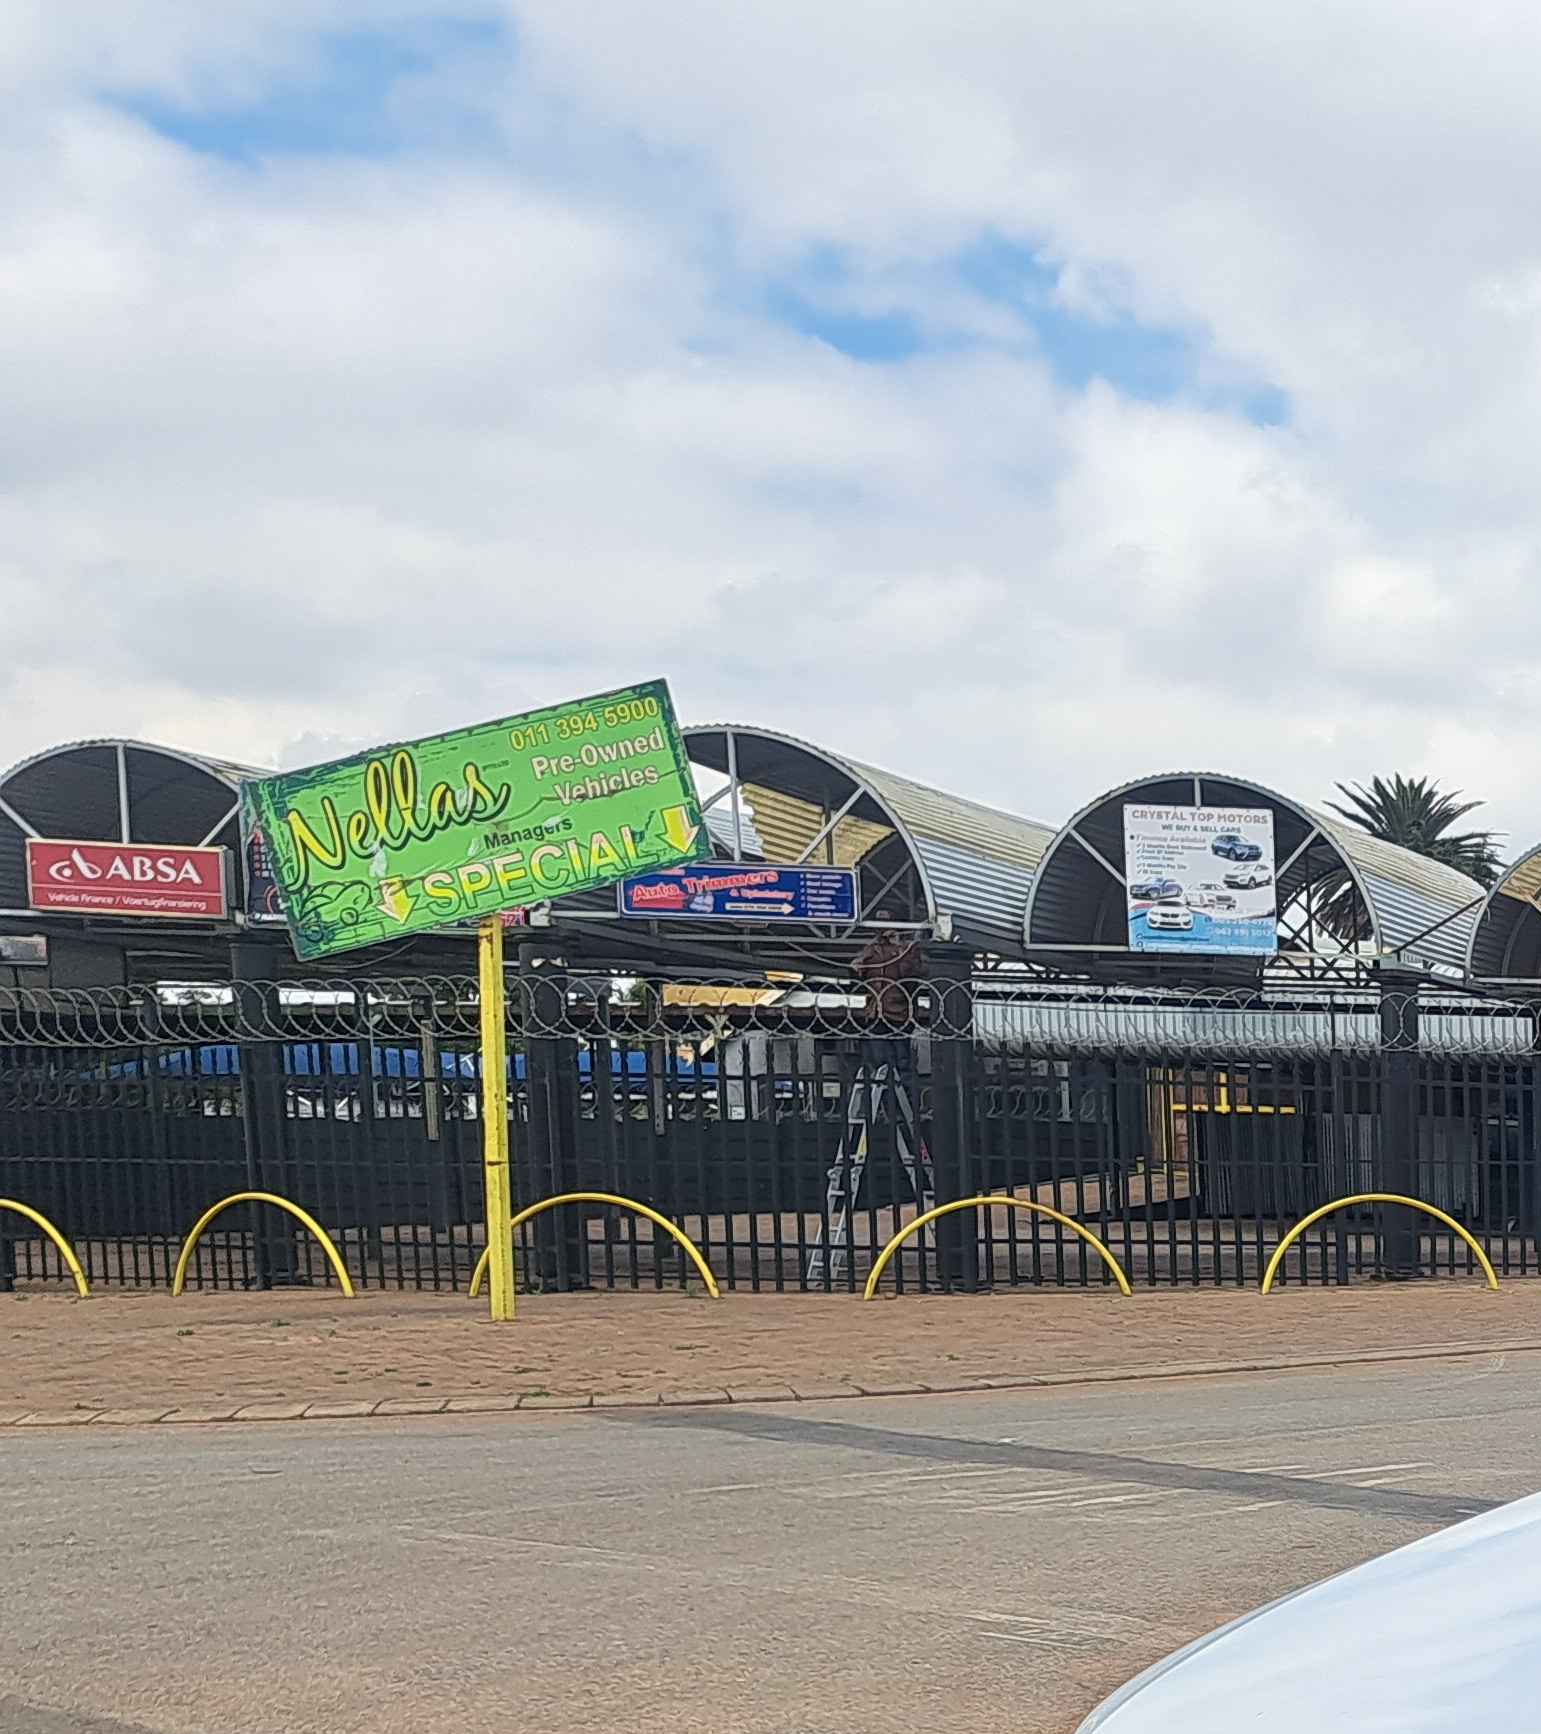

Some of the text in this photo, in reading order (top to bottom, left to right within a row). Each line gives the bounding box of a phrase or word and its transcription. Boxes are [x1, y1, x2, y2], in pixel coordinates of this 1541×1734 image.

[511, 697, 659, 750] 011 394 5900
[530, 727, 665, 781] Pre-Owned
[554, 765, 659, 806] Vehicles
[283, 749, 511, 890] Nellas
[484, 817, 573, 849] Managers
[1132, 810, 1268, 825] CRYSTAL TOP MOTORS
[1175, 824, 1191, 832] BUY
[1200, 825, 1218, 833] SELL
[105, 855, 203, 885] ABSA
[421, 825, 660, 916] SPECIAL
[632, 883, 681, 900] Auto
